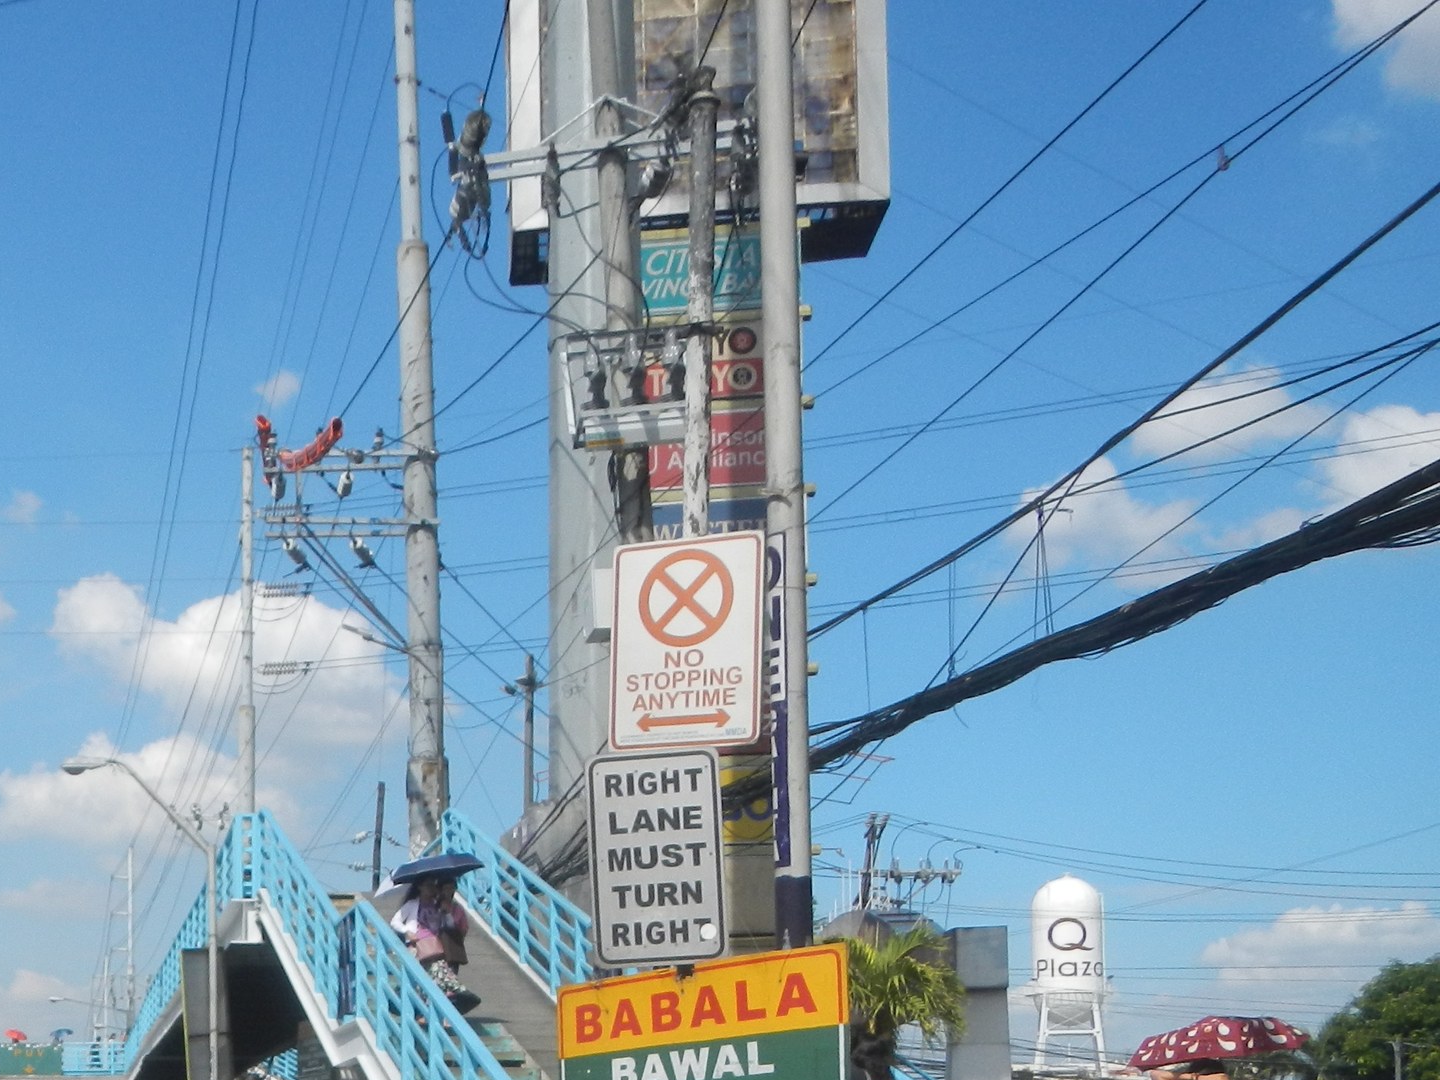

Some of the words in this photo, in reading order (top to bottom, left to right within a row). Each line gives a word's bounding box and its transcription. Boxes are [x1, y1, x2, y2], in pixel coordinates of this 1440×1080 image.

[664, 649, 704, 669] NO
[626, 666, 743, 692] STOPPING
[632, 687, 737, 712] ANYTIME
[604, 768, 703, 798] RIGHT
[608, 806, 703, 835] LANE
[607, 842, 707, 872] MUST
[611, 880, 703, 909] TURN
[611, 917, 712, 947] RIGHT
[1048, 917, 1094, 951] Q
[576, 972, 818, 1044] BABALA
